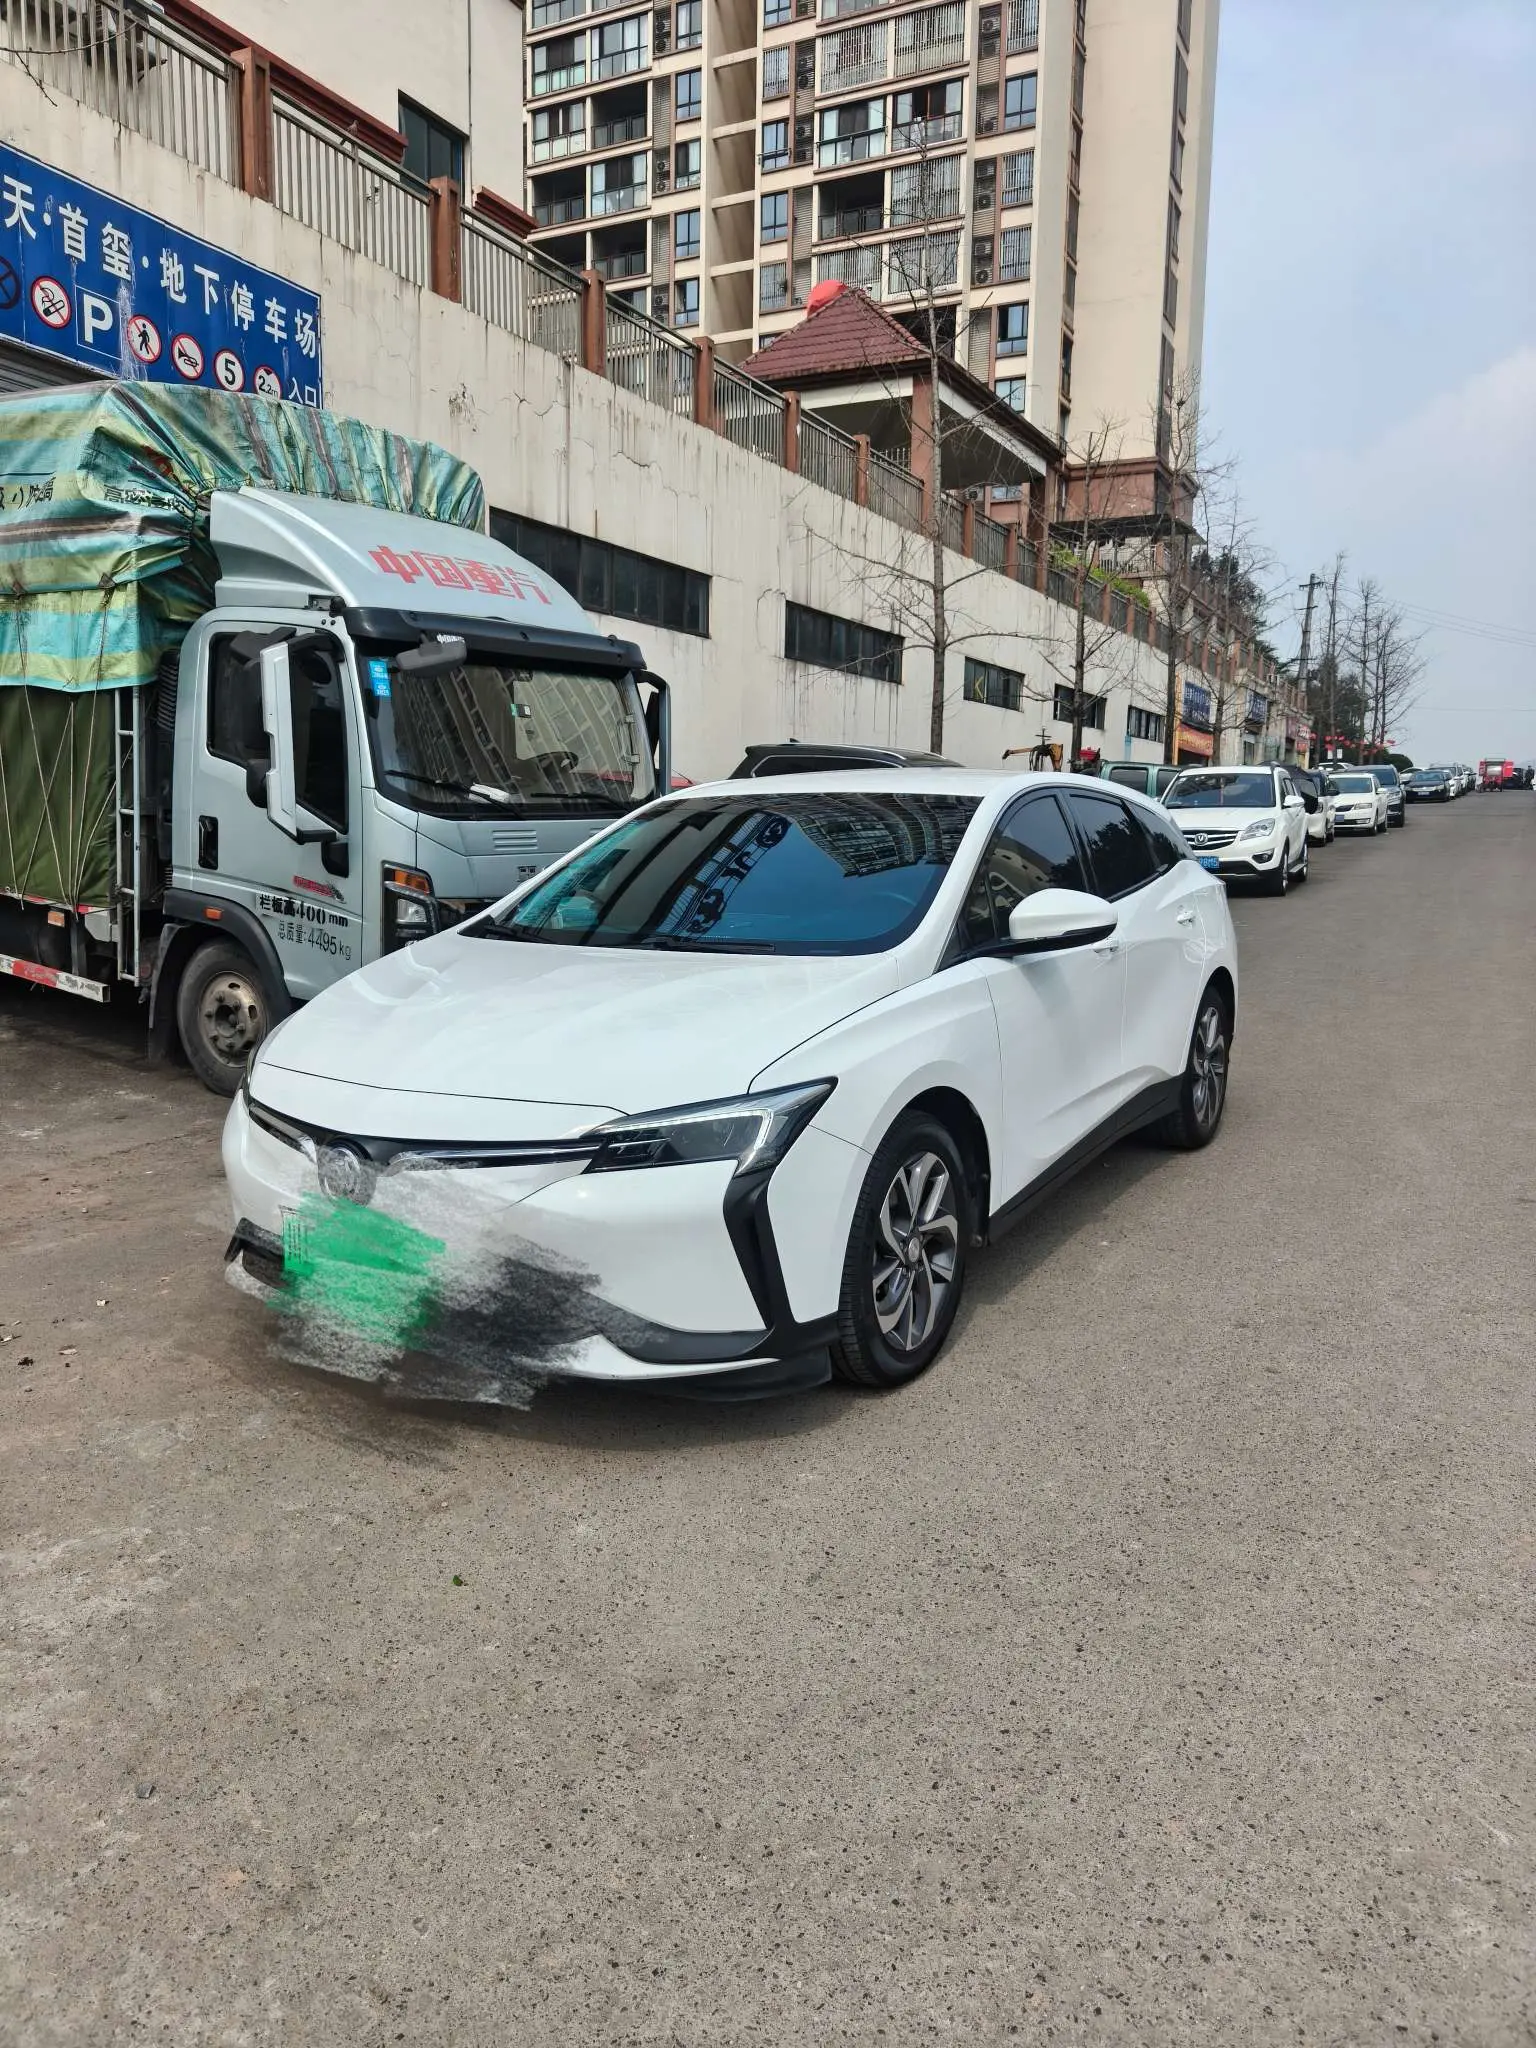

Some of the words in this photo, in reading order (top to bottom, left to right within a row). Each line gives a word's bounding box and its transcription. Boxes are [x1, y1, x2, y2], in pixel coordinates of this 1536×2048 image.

[83, 293, 114, 343] P
[224, 358, 236, 386] 5
[288, 377, 316, 408] 入口
[368, 545, 551, 604] 中国重汽
